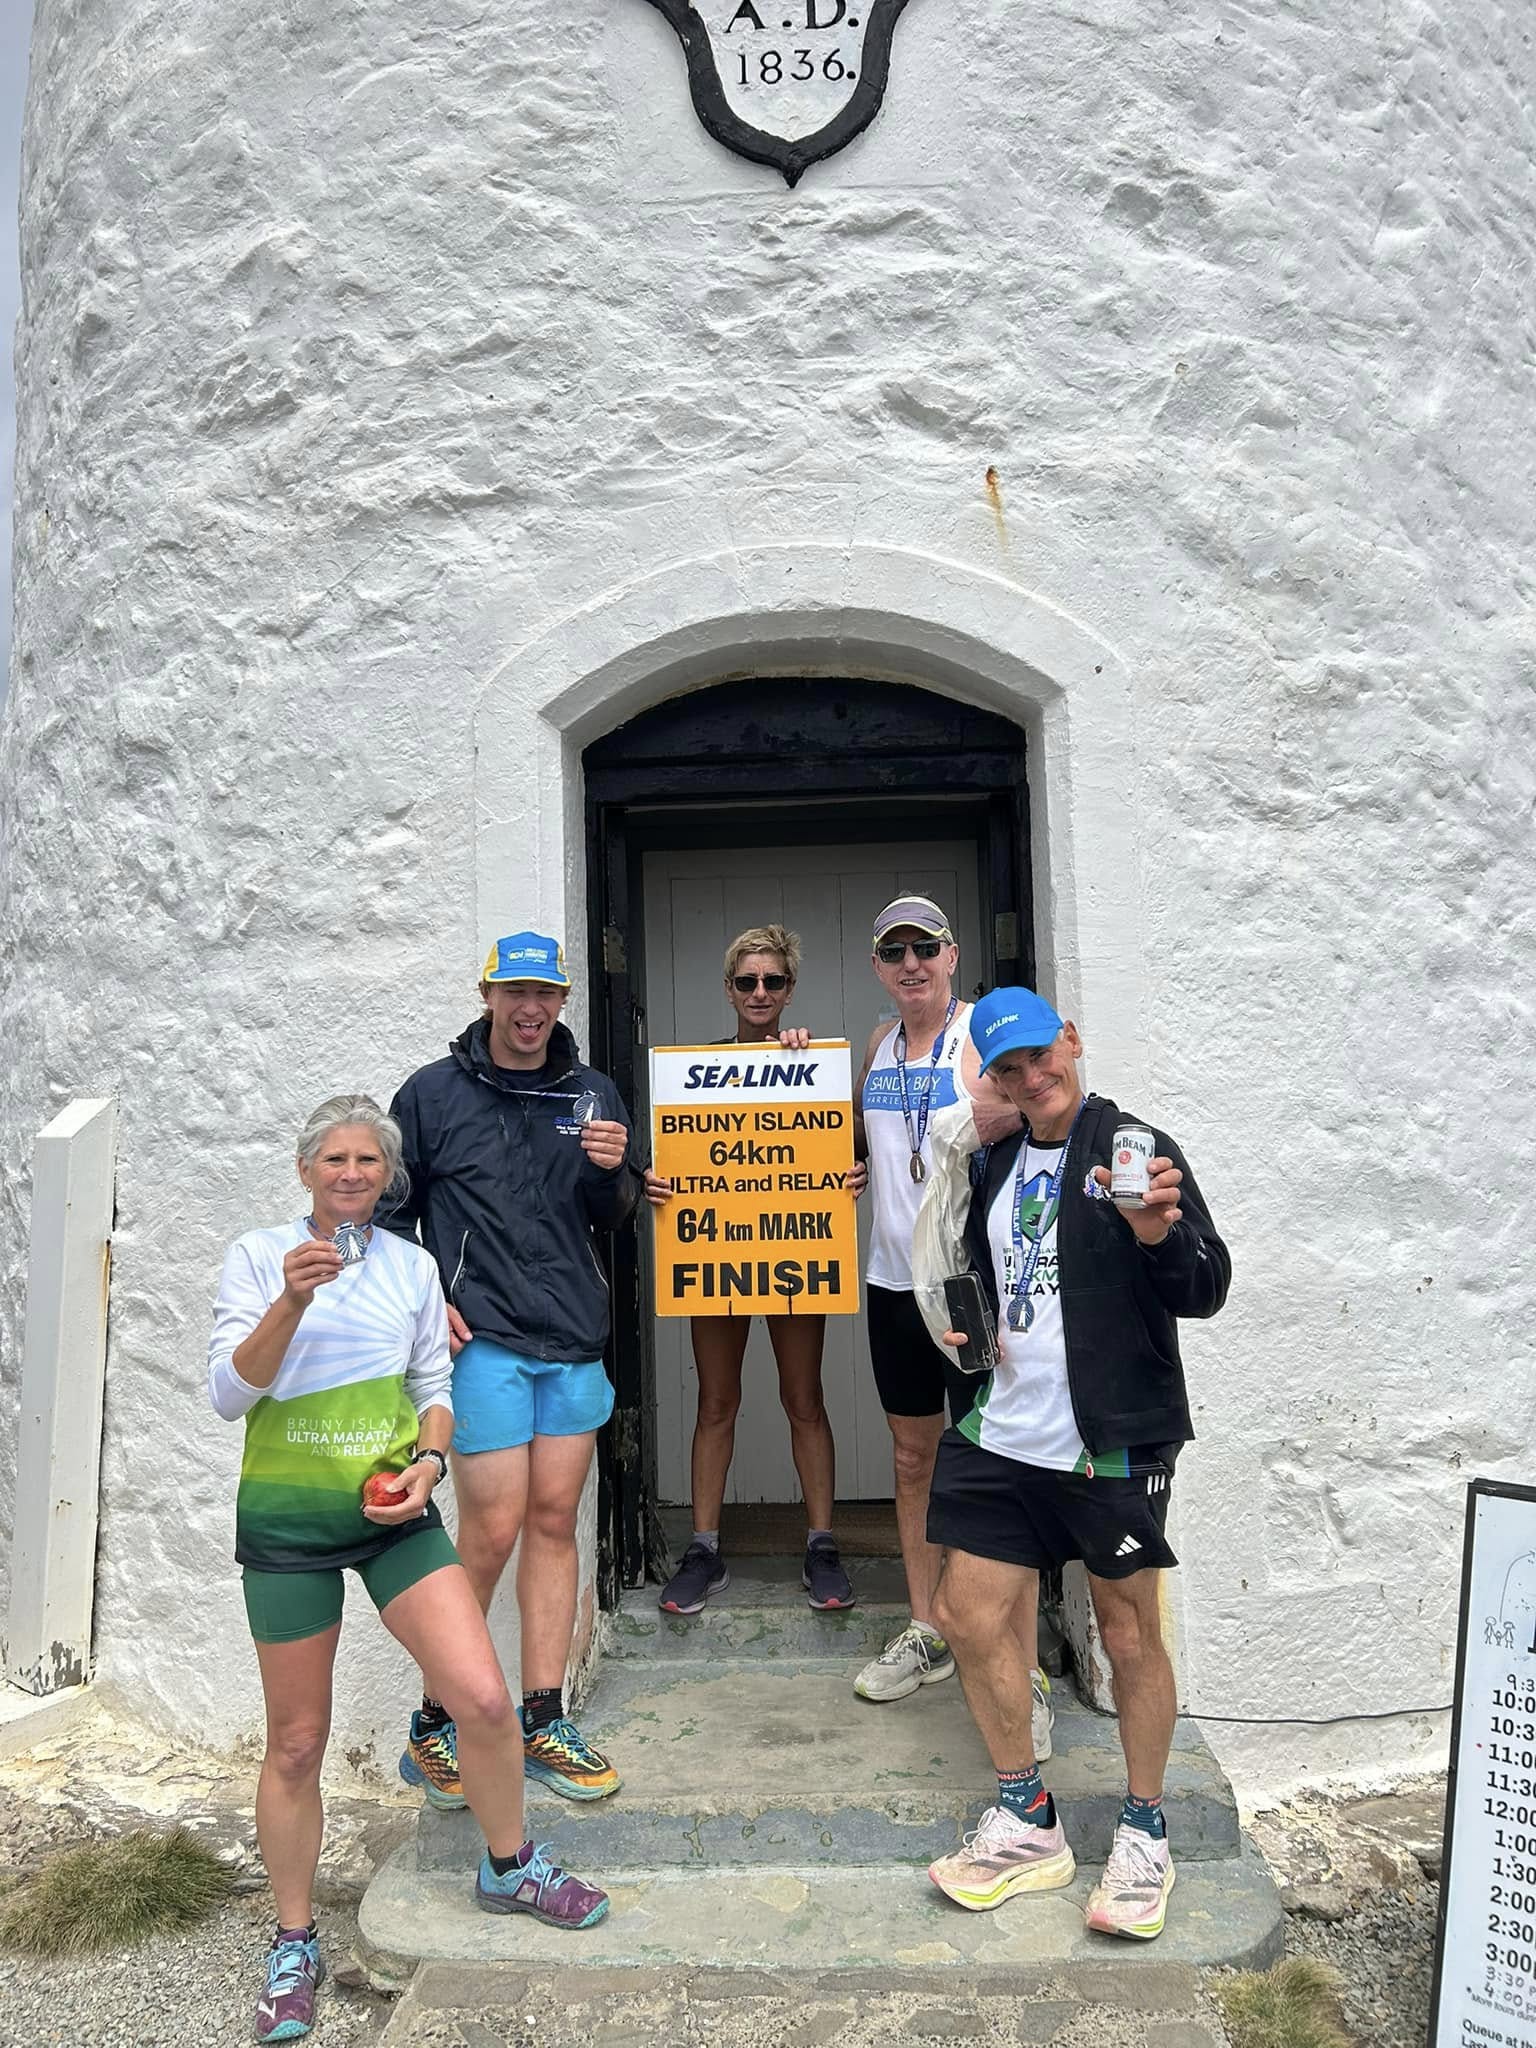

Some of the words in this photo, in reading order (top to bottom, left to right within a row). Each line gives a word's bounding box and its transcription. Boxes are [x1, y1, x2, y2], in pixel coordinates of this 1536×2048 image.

[737, 48, 857, 85] 1836.
[985, 1013, 1020, 1038] SEALINK
[947, 1037, 959, 1060] 2XU
[684, 1063, 819, 1089] SEALINK
[661, 1113, 747, 1134] BRUNY
[754, 1110, 844, 1132] ISLAND
[709, 1140, 795, 1166] 64km
[1122, 1137, 1146, 1157] BEAM
[734, 1174, 772, 1193] and
[778, 1172, 847, 1192] RELAY
[676, 1208, 718, 1243] 64
[725, 1221, 753, 1242] km
[759, 1212, 833, 1241] MARK
[1004, 1255, 1060, 1269] URA
[672, 1260, 841, 1298] FINISH
[287, 1417, 345, 1431] BRUNY
[351, 1417, 397, 1431] ISLA
[287, 1430, 330, 1444] ULTRA
[333, 1430, 399, 1444] MARATH
[310, 1444, 340, 1457] AND
[343, 1442, 389, 1457] RELAY
[1489, 1743, 1536, 1769] 11:0
[1487, 1771, 1536, 1797] 11:3
[1490, 1885, 1536, 1914] 2:00
[1488, 1914, 1536, 1944] 2:30
[1486, 1943, 1536, 1977] 3:00
[1462, 2018, 1503, 2043] Queue
